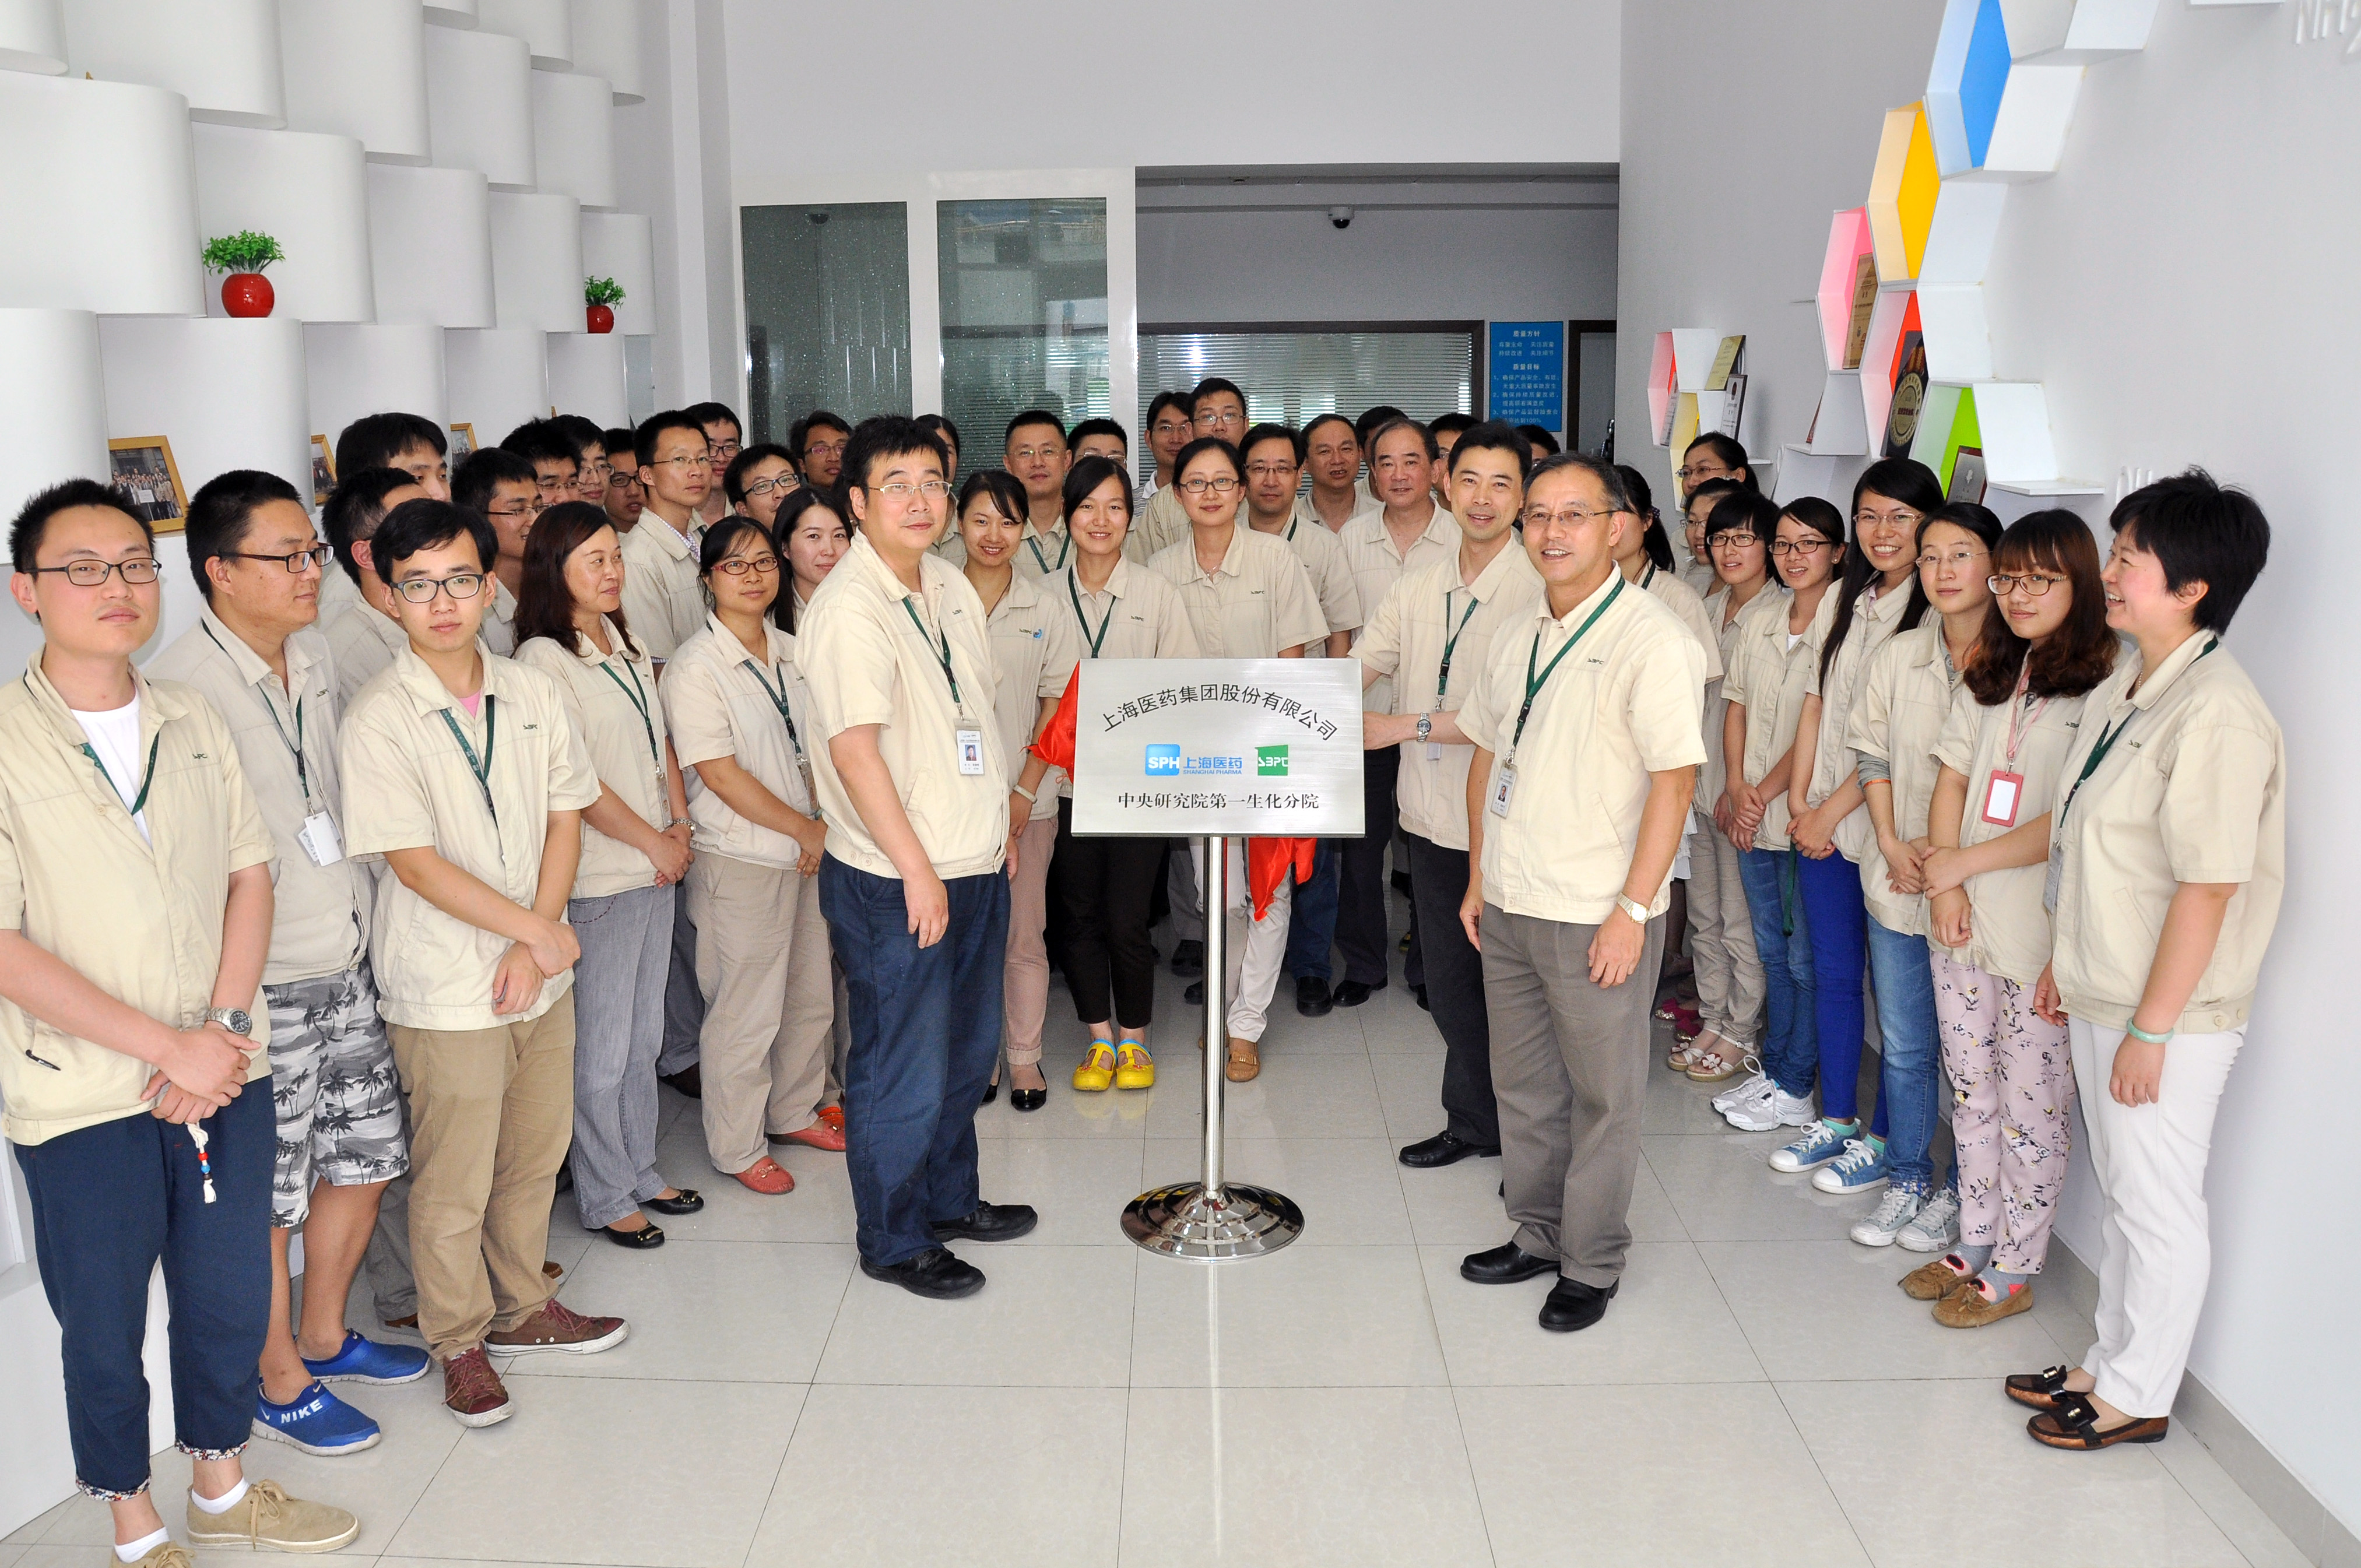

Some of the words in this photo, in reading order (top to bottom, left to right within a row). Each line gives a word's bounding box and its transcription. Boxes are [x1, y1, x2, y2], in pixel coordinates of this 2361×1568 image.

[1102, 684, 1338, 741] 上海医药集团股份有限公司
[1148, 757, 1180, 769] SPH
[1183, 757, 1243, 769] 上海医药
[1118, 792, 1320, 810] 中央研究院第一生化分院
[281, 1399, 323, 1423] NIKE
